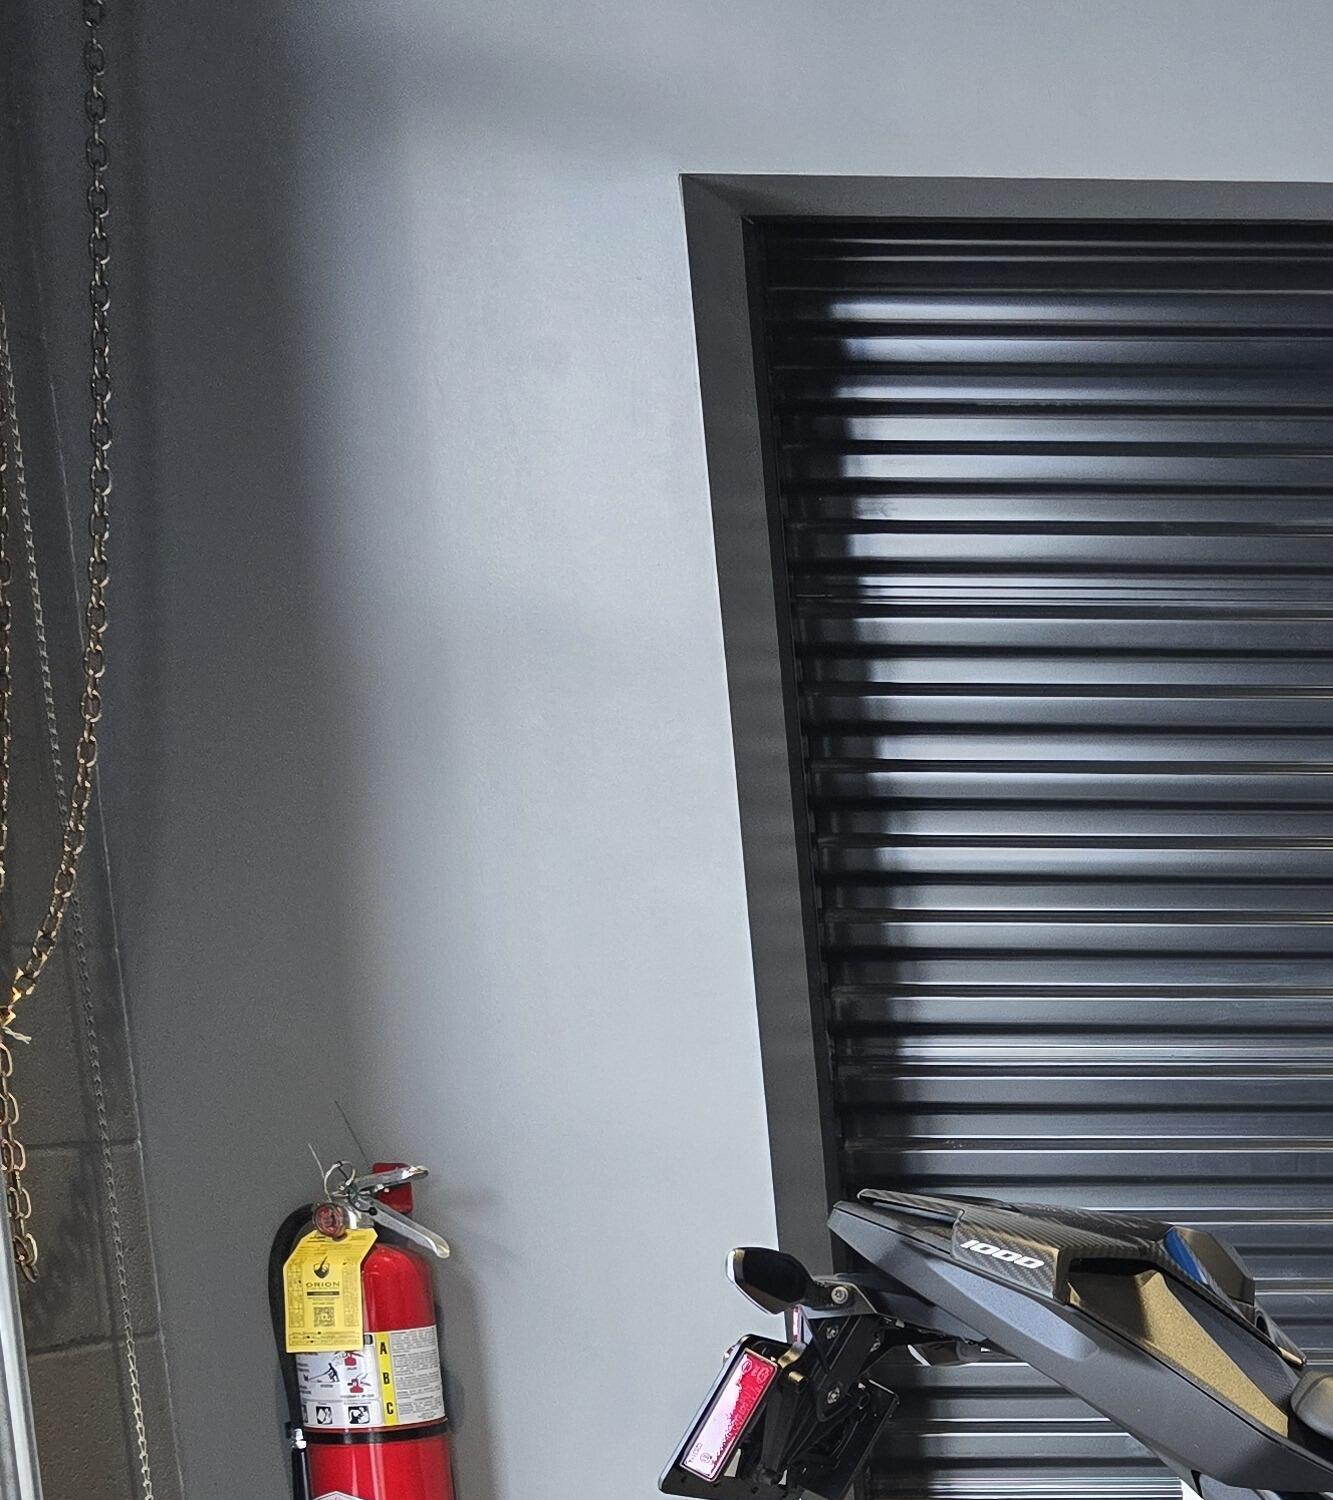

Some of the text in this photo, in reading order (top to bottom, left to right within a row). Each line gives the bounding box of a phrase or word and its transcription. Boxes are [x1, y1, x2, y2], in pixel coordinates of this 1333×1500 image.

[960, 1240, 1045, 1269] 1000
[380, 1342, 388, 1355] A
[383, 1372, 390, 1385] B
[386, 1402, 394, 1415] C
